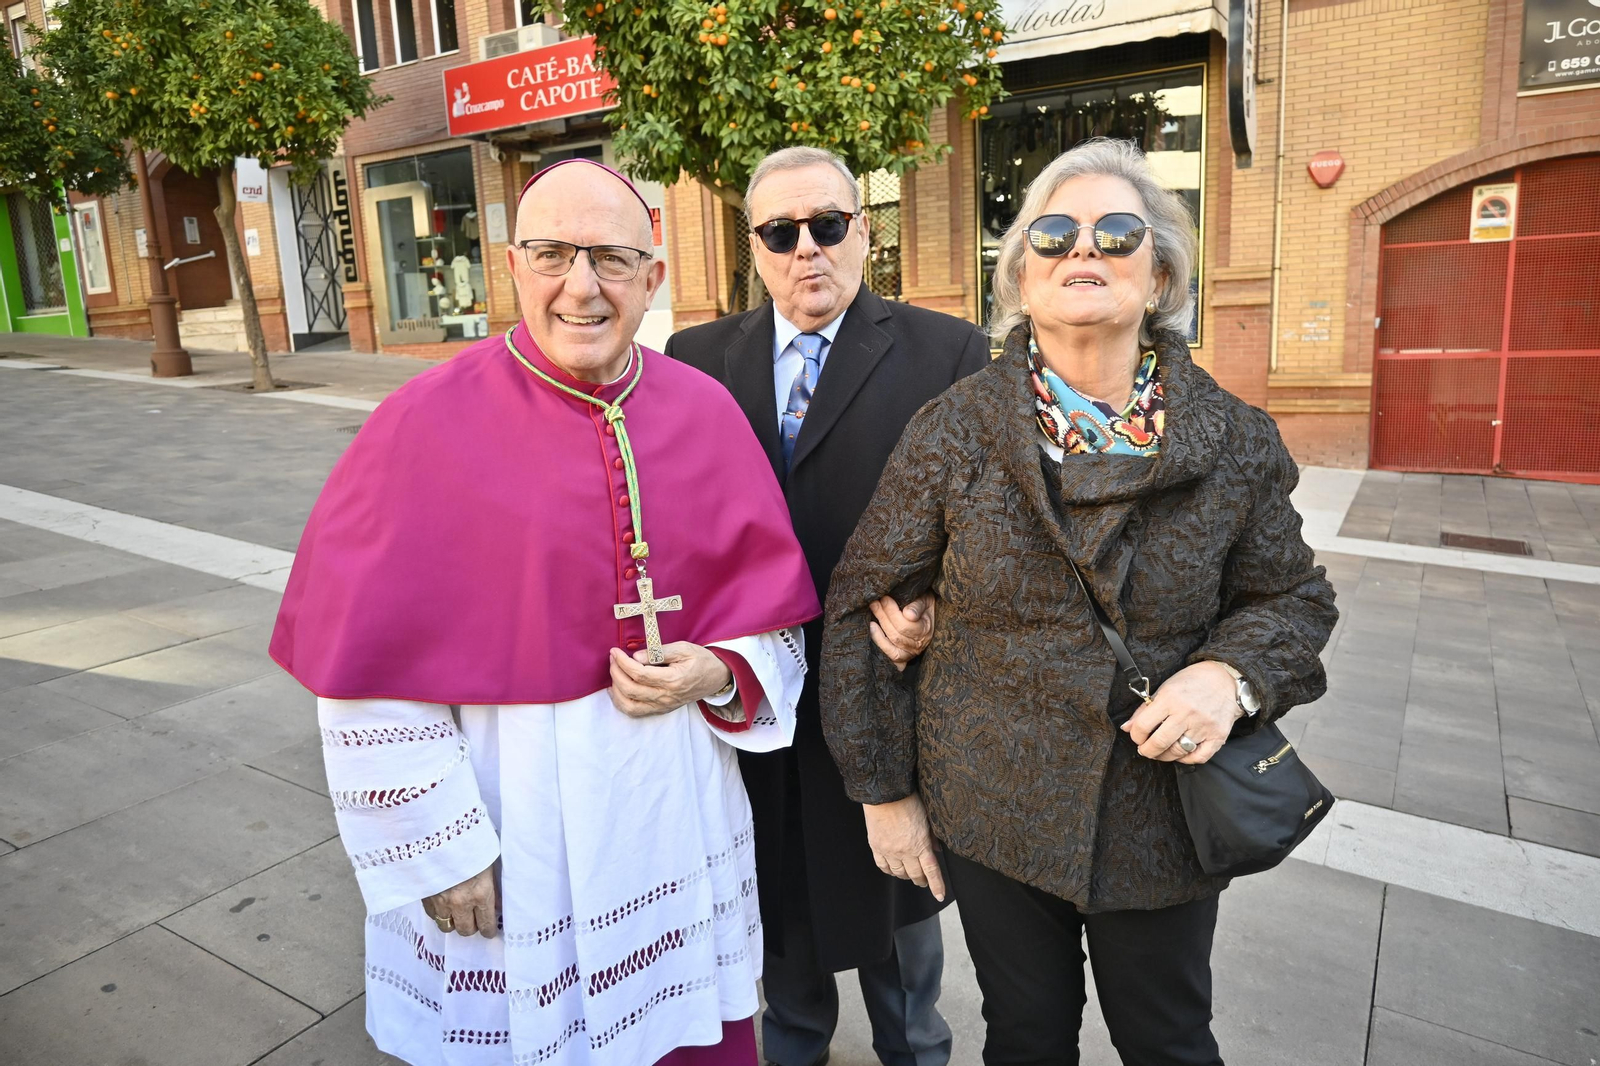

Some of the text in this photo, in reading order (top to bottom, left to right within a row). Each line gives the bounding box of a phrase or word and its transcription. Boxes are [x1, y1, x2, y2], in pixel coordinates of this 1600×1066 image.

[506, 53, 603, 89] CAFÉ-BA
[1560, 56, 1591, 70] 659
[519, 77, 602, 111] CAPOTE
[465, 99, 505, 115] Cruzcampo
[1311, 159, 1341, 168] FUEGO
